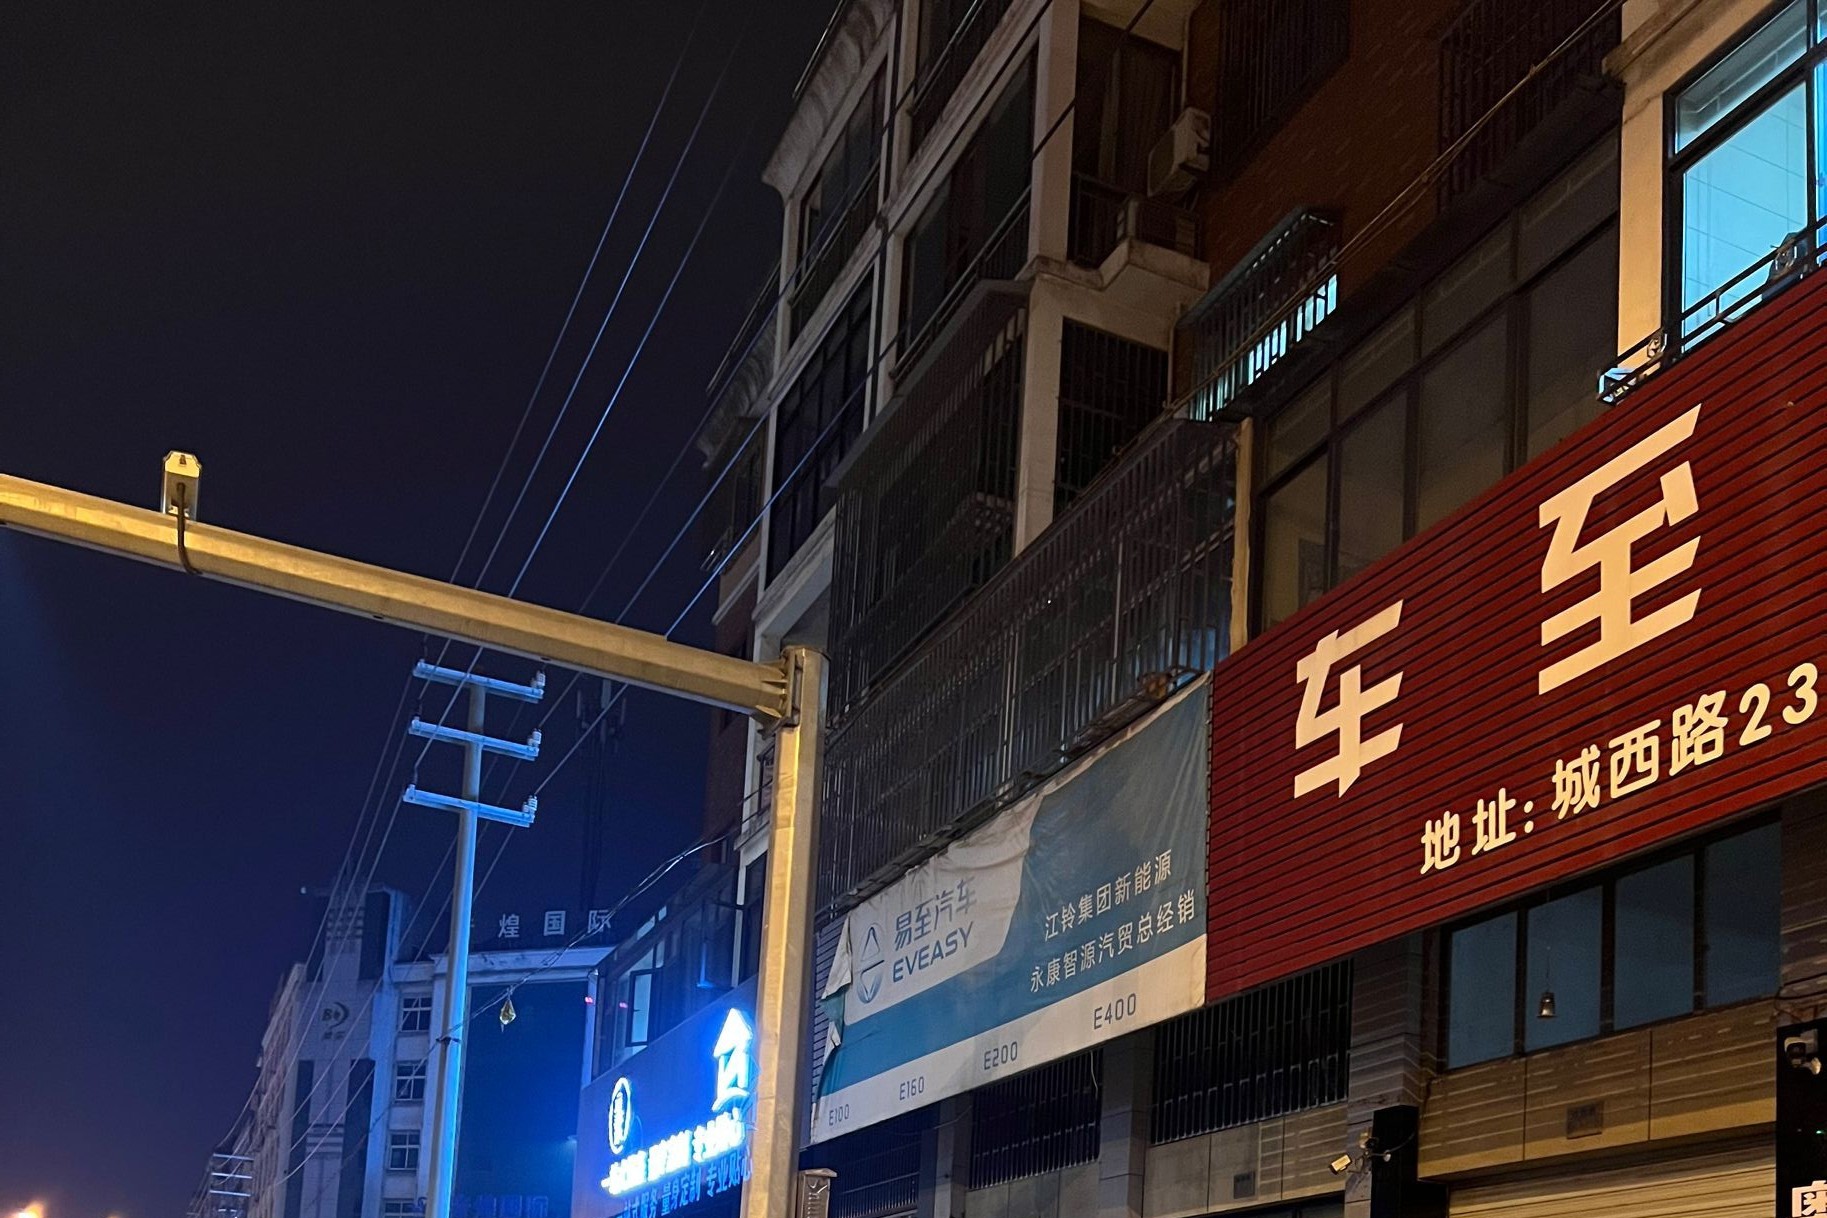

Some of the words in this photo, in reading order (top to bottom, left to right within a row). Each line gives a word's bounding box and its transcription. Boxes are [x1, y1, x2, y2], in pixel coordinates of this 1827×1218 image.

[894, 876, 977, 952] 易至汽车
[1044, 848, 1173, 943] 江铃集团新能源
[470, 908, 612, 939] 煌国际
[1030, 888, 1196, 994] 永康智源汽贸总经销
[892, 920, 974, 983] EVEASY
[1093, 992, 1137, 1031] E400
[983, 1040, 1019, 1071] E200
[899, 1075, 925, 1101] E160
[828, 1103, 850, 1127] E100
